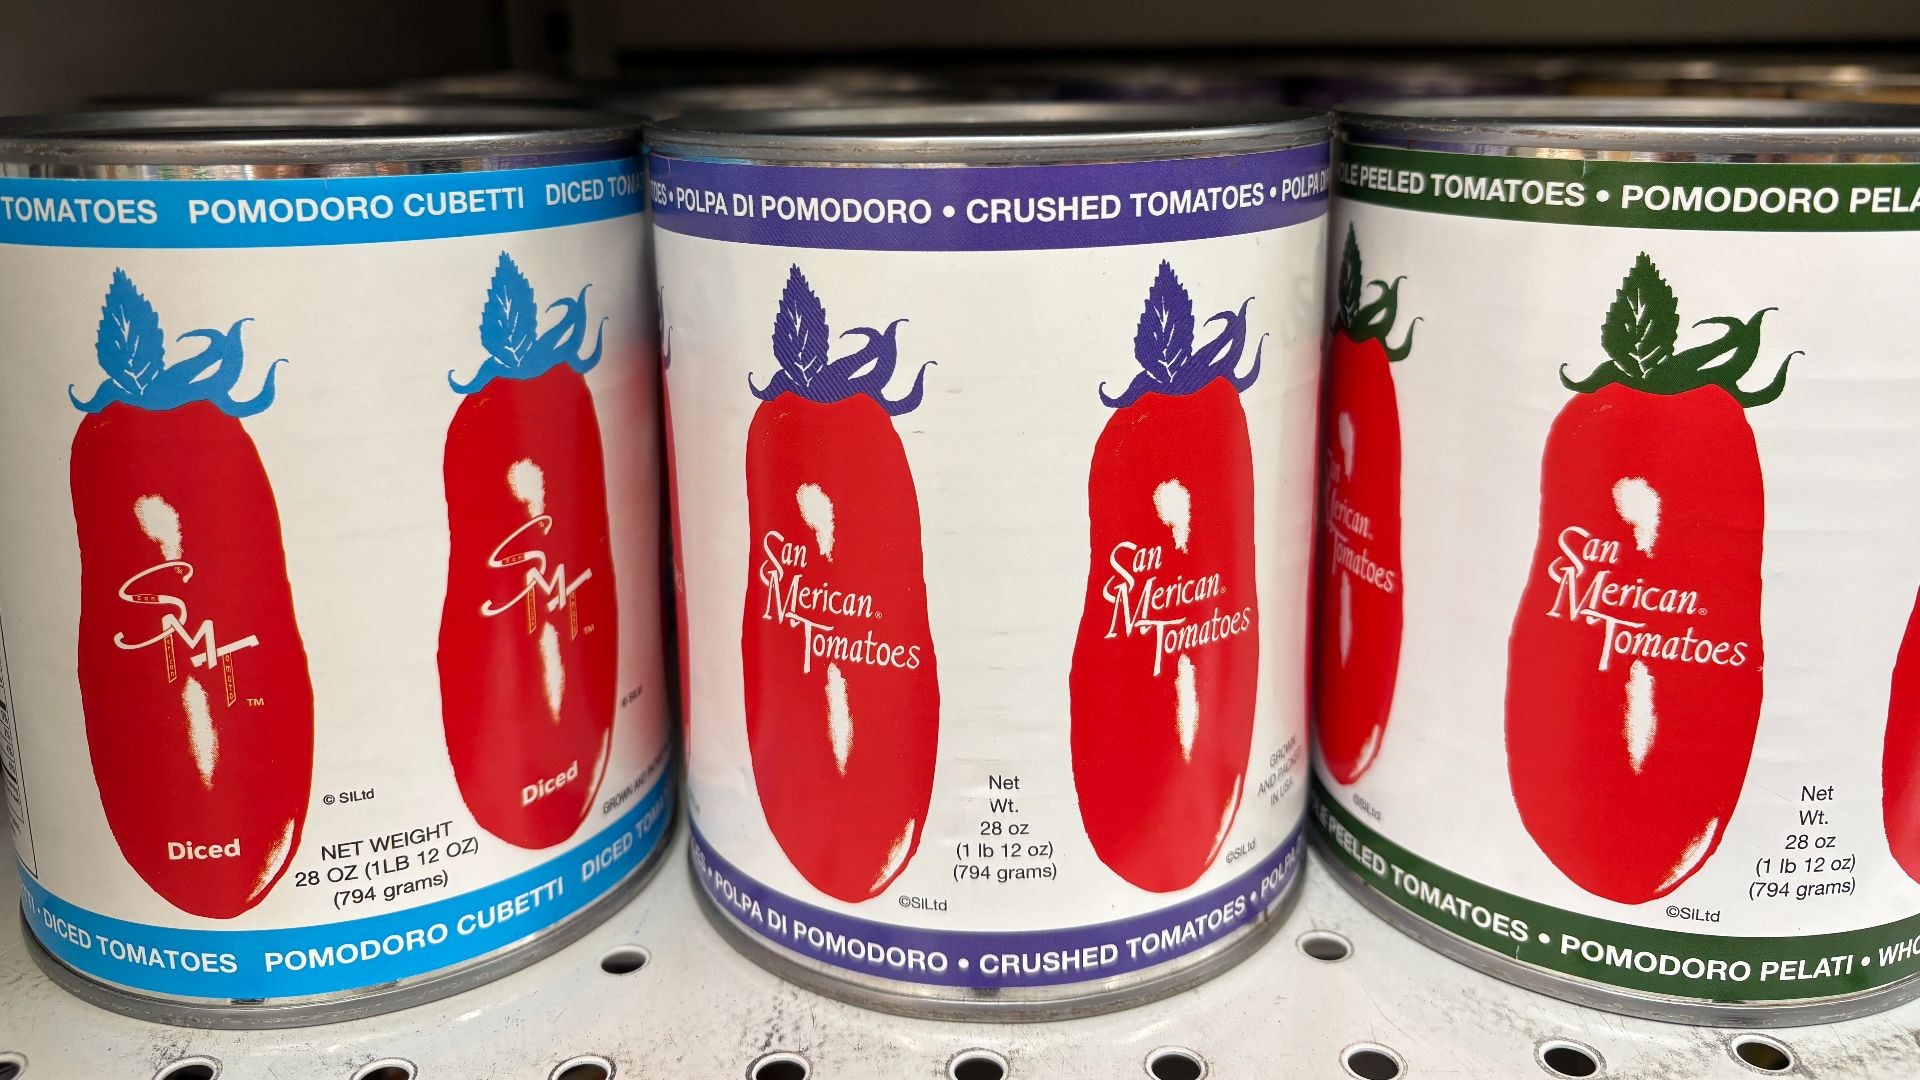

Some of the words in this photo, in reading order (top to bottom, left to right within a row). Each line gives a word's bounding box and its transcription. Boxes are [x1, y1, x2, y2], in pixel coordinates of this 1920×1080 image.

[1, 195, 159, 224] TOMATOES
[189, 194, 395, 224] POMODORO
[404, 186, 524, 217] CUBETTI
[545, 179, 605, 206] DICED
[676, 186, 729, 216] POLPA
[733, 193, 754, 218] DI
[761, 195, 932, 225] POMODORO
[966, 194, 1122, 225] CRUSHED
[1129, 182, 1265, 218] TOMATOES
[1281, 172, 1319, 202] POLPA
[1360, 165, 1425, 195] PEELED
[1430, 173, 1585, 207] TOMATOES
[1621, 184, 1839, 214] POMODORO
[759, 530, 808, 588] San
[1102, 541, 1162, 604] San
[1327, 523, 1396, 594] Tomatoes
[1548, 526, 1619, 584] San
[785, 612, 921, 674] Tomatoes
[1134, 607, 1251, 677] Tomatoes
[1580, 608, 1749, 672] Tomatoes
[339, 787, 376, 804] SILtd
[521, 760, 578, 807] Diced
[988, 774, 1021, 790] Net
[1800, 785, 1834, 802] Net
[989, 798, 1019, 813] Wt.
[1799, 809, 1829, 826] Wt.
[166, 837, 241, 861] Diced
[321, 839, 365, 861] NET
[369, 820, 454, 853] WEIGHT
[956, 842, 970, 861] (1
[978, 842, 994, 858] lb
[1001, 843, 1022, 858] 12
[1027, 841, 1054, 859] oz)
[980, 821, 1003, 836] 28
[1008, 822, 1030, 836] oz
[1784, 834, 1809, 850] 28
[1814, 835, 1836, 849] oz
[295, 869, 321, 888] 28
[326, 864, 360, 884] OZ
[364, 854, 410, 881] (1LB
[417, 847, 440, 867] 12
[445, 835, 480, 859] OZ)
[953, 864, 991, 883] (794
[997, 863, 1058, 883] grams)
[1755, 857, 1771, 876] (1
[1779, 857, 1797, 874] lb
[1804, 857, 1825, 873] 12
[1830, 853, 1856, 873] oz)
[43, 907, 92, 949] DICED
[95, 934, 238, 974] TOMATOES
[264, 922, 449, 973] POMODORO
[456, 876, 564, 936] CUBETTI
[581, 831, 633, 882] DICED
[333, 885, 377, 910] (794
[382, 869, 449, 901] grams)
[1329, 815, 1386, 876] PEELED
[1390, 863, 1529, 943] TOMATOES
[1560, 933, 1751, 982] POMODORO
[1760, 954, 1854, 982] PELATI
[1749, 881, 1790, 900] (794
[1795, 876, 1856, 901] grams)
[715, 870, 763, 923] POLPA
[767, 907, 788, 935] DI
[793, 918, 949, 973] POMODORO
[978, 943, 1119, 976] CRUSHED
[1125, 894, 1246, 959] TOMATOES
